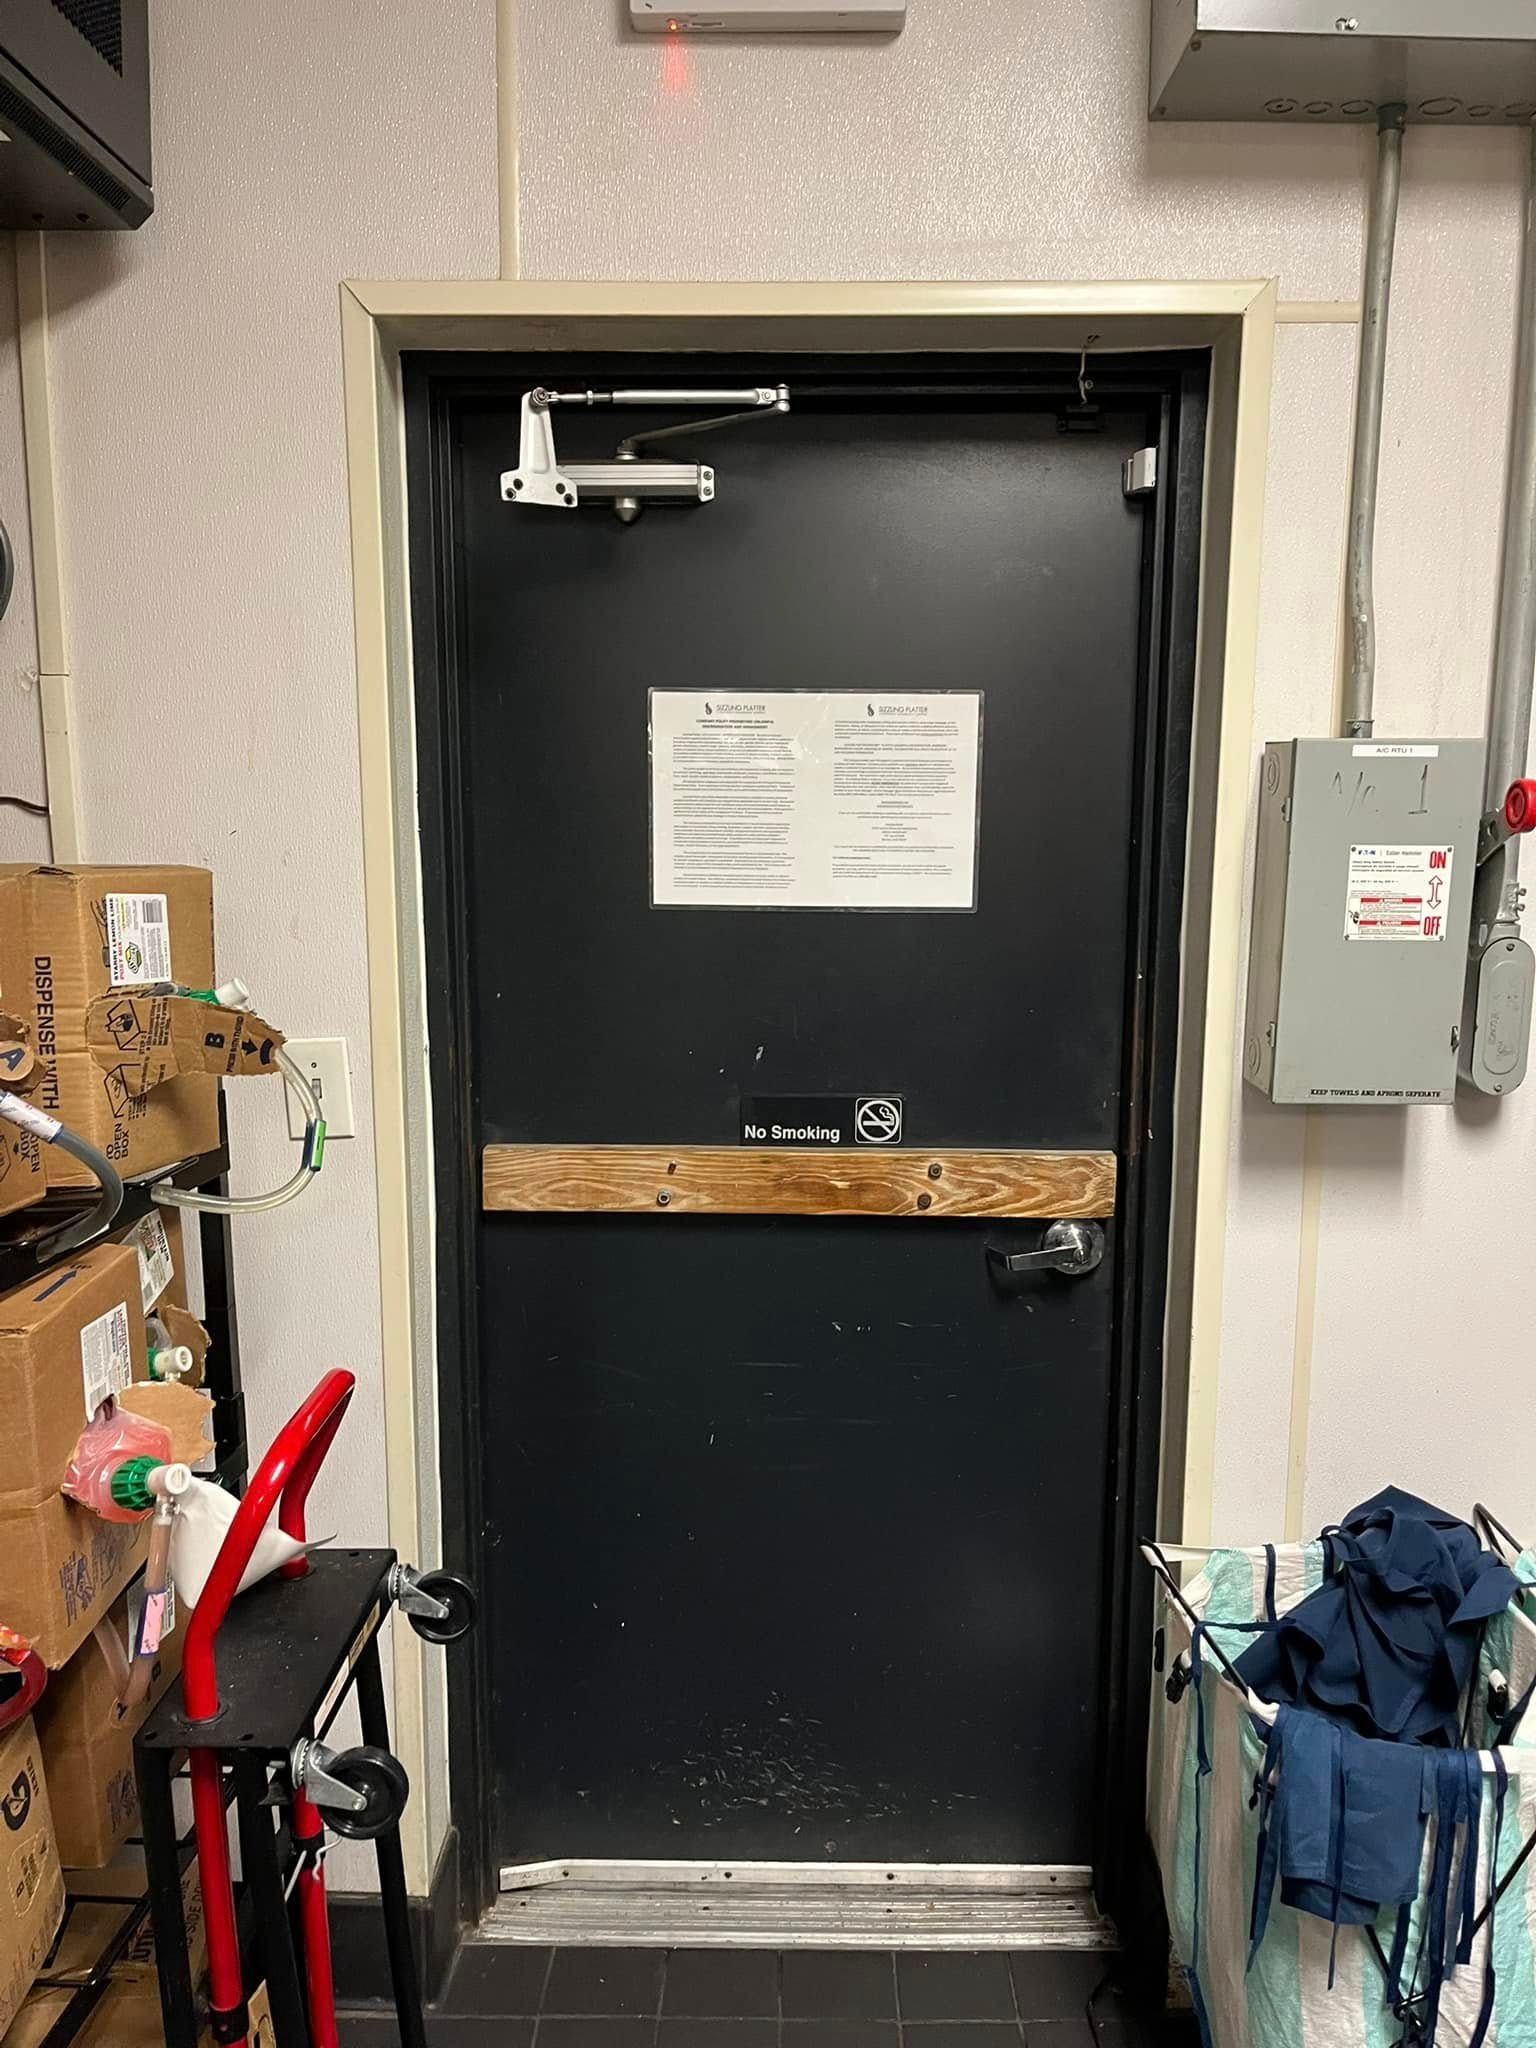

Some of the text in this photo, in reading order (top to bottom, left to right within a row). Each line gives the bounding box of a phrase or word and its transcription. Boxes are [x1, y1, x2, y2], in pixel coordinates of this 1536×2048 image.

[1429, 850, 1447, 869] ON
[1423, 916, 1442, 936] OFF
[111, 949, 119, 981] STARRY
[34, 956, 56, 1056] DISPENSE
[204, 1032, 225, 1049] B
[0, 1047, 25, 1072] A
[1405, 1090, 1441, 1098] SEPERATE
[114, 1123, 122, 1160] OPEN
[121, 1129, 129, 1158] BOX
[744, 1124, 840, 1143] No Smoking
[20, 1131, 31, 1162] BOX
